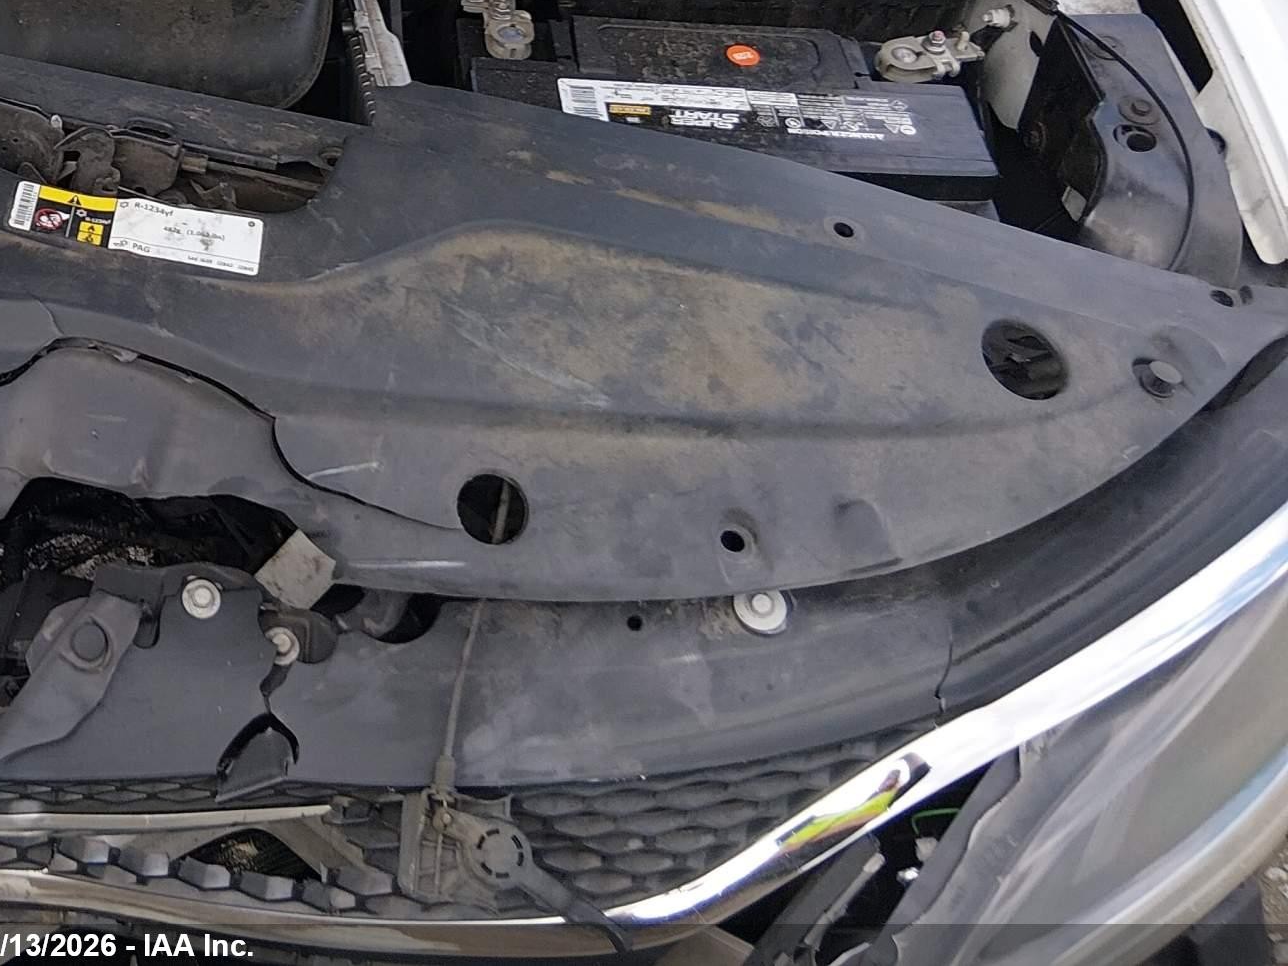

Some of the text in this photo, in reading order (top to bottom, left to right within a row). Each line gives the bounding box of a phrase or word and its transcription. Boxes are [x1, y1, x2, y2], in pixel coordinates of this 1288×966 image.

[669, 116, 734, 130] SUPER
[134, 201, 175, 218] R-1234yf
[132, 242, 152, 253] PAG
